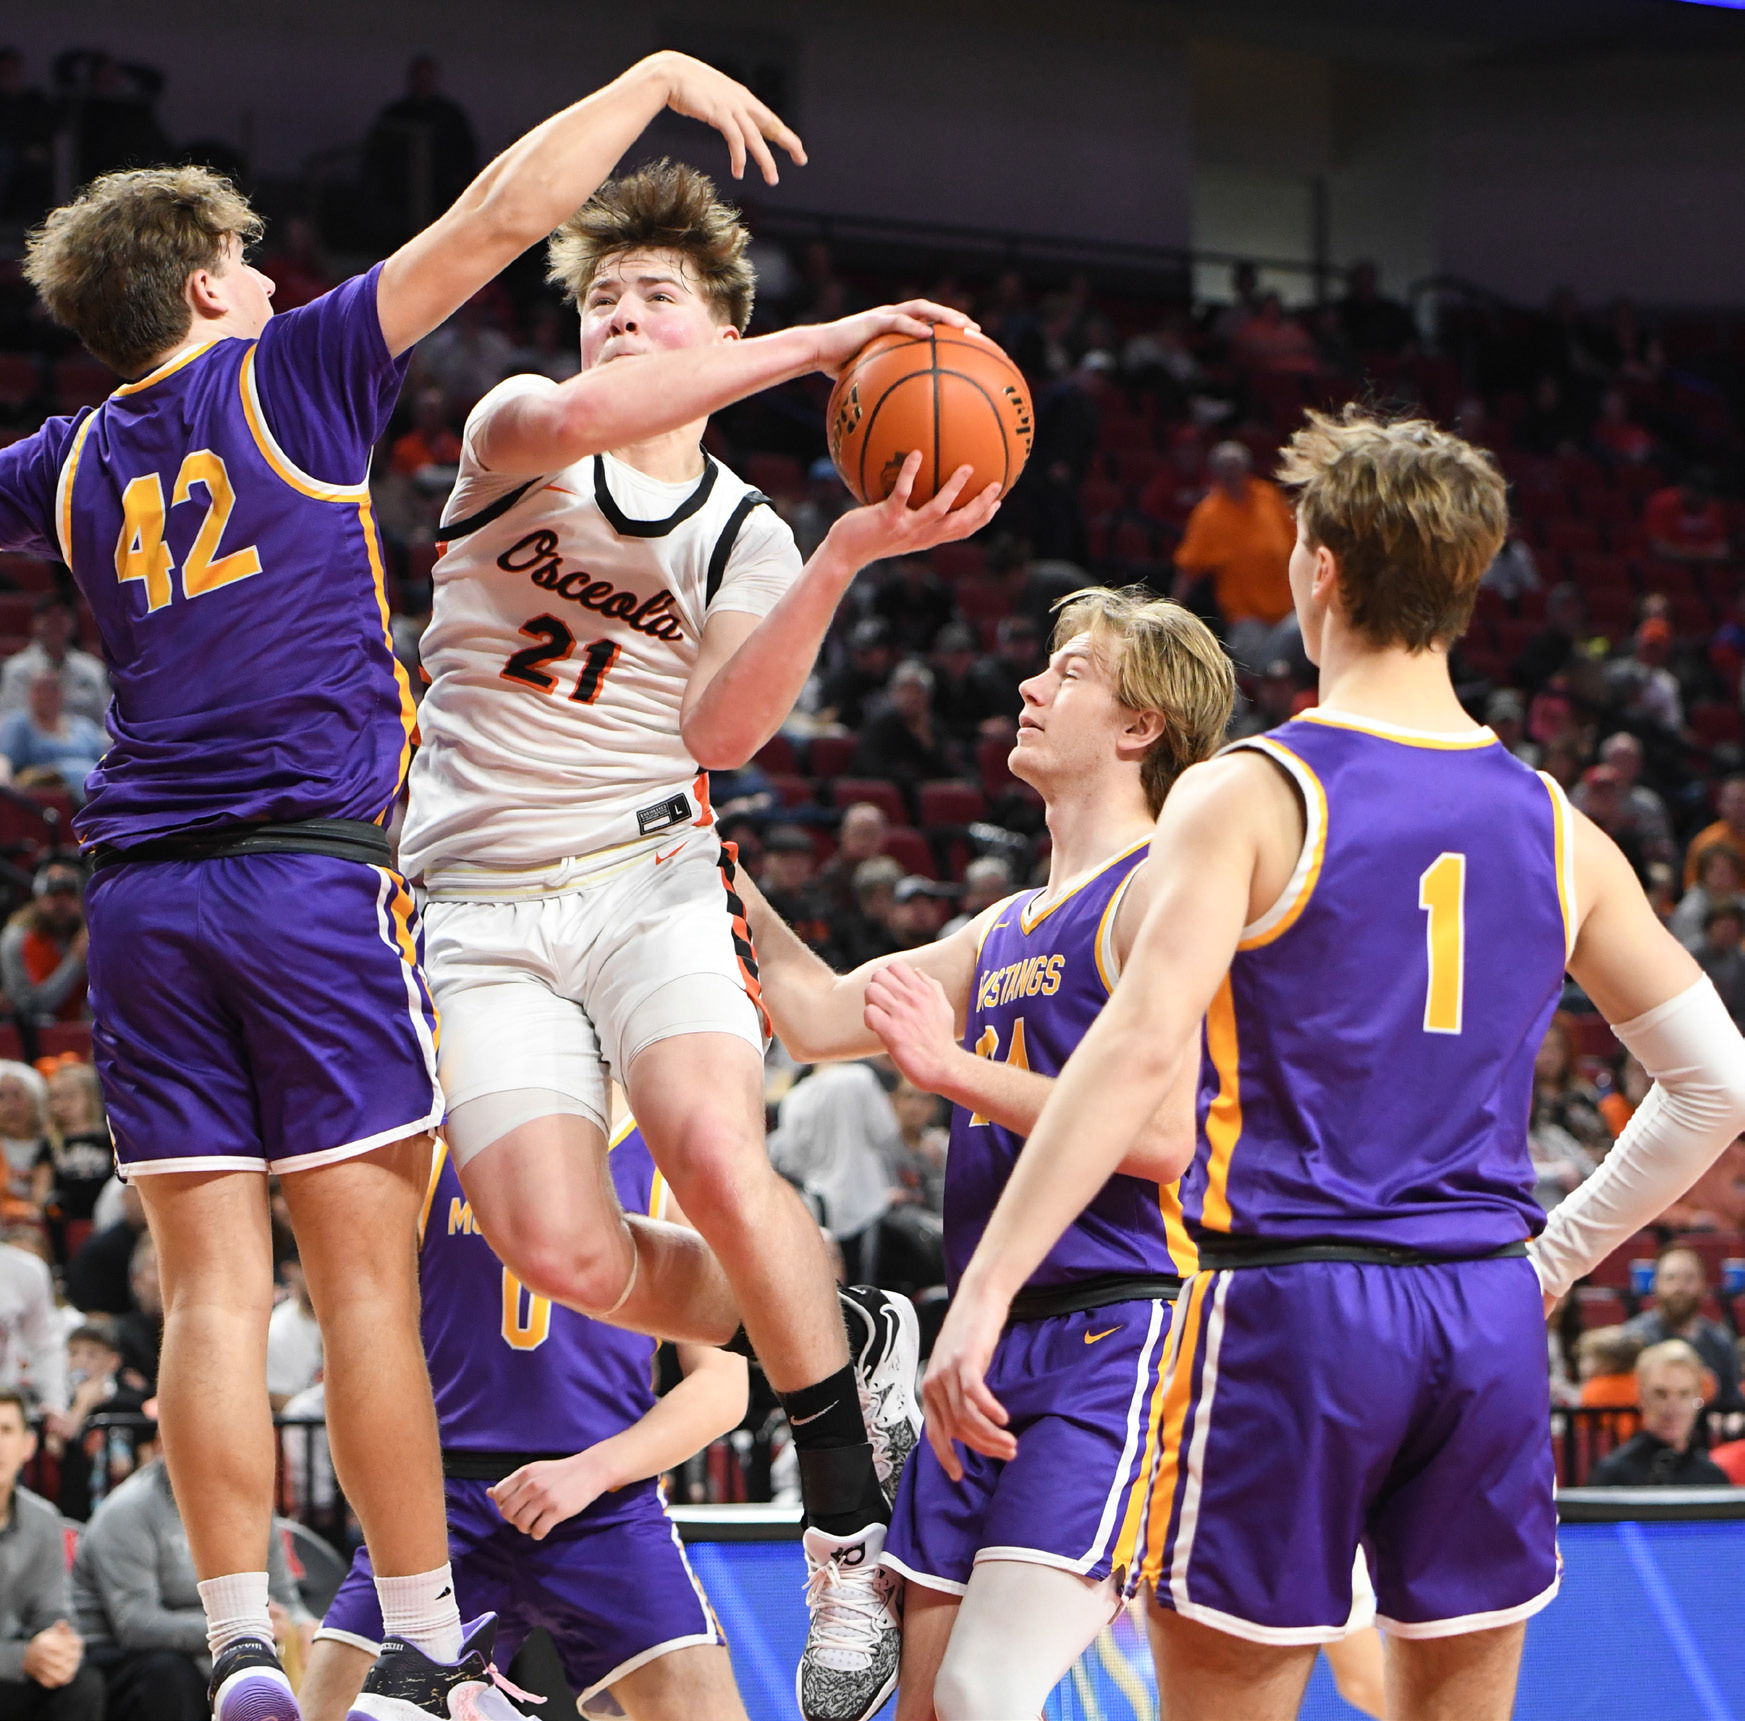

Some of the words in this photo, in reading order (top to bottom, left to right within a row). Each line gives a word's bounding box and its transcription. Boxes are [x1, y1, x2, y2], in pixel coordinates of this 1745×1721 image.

[114, 449, 263, 613] 42
[497, 529, 684, 641] Osceola
[500, 613, 622, 706] 21
[674, 804, 683, 815] L
[1418, 852, 1466, 1035] 1
[501, 1266, 551, 1351] 0
